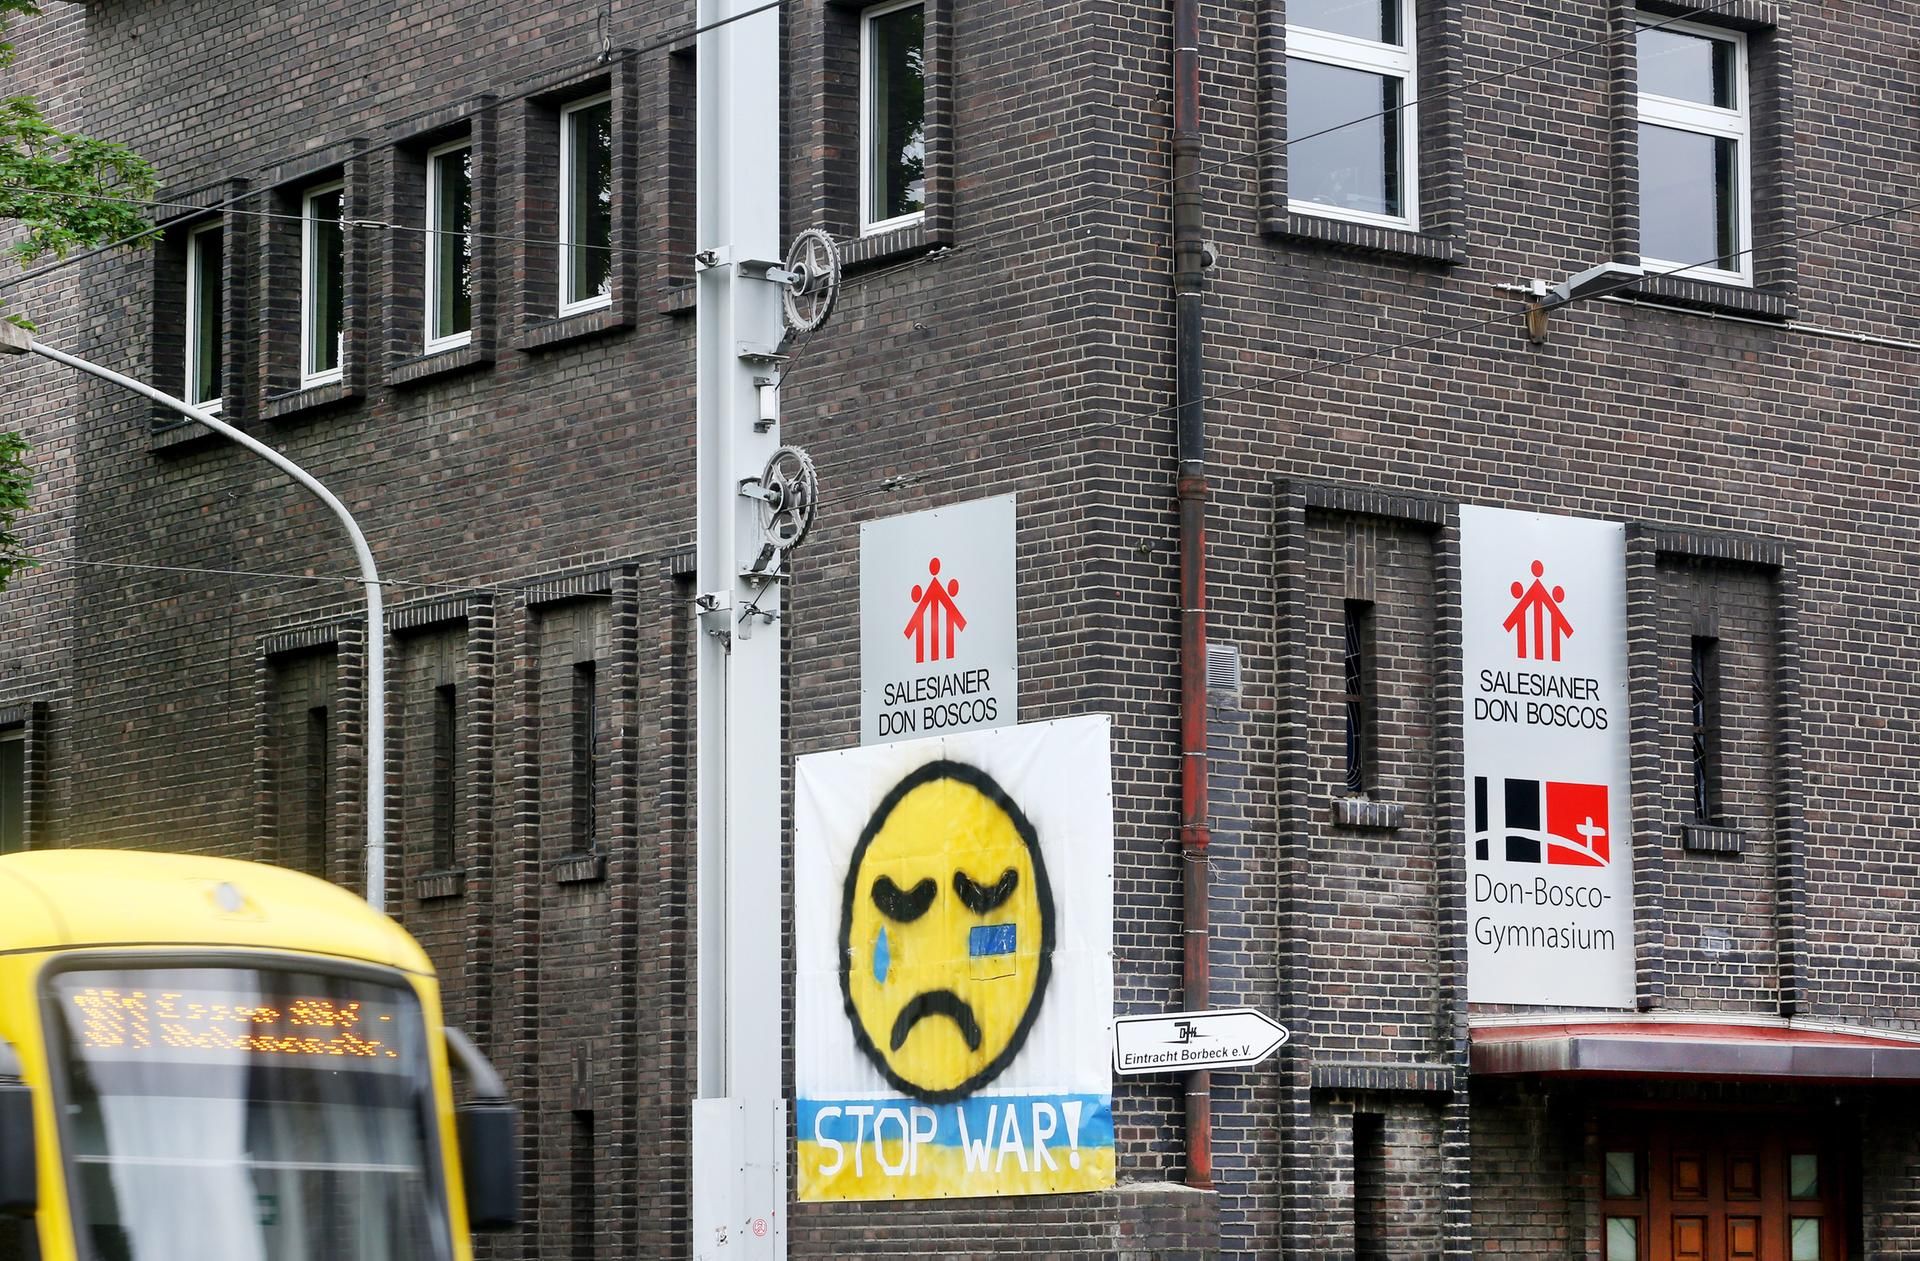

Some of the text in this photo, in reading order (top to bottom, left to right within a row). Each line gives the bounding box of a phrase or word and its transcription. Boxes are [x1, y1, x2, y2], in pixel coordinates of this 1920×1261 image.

[883, 668, 990, 706] SALESIANER
[1480, 669, 1600, 701] SALESIANER
[879, 697, 998, 736] DON BOSCOS
[1474, 697, 1608, 730] DON BOSCOS
[1475, 873, 1612, 908] Don-Bosco-
[1475, 916, 1615, 954] Gymnasium
[1124, 1045, 1251, 1065] Eintracht Borbeck e.V.
[814, 1100, 1083, 1177] STOP WAR!
